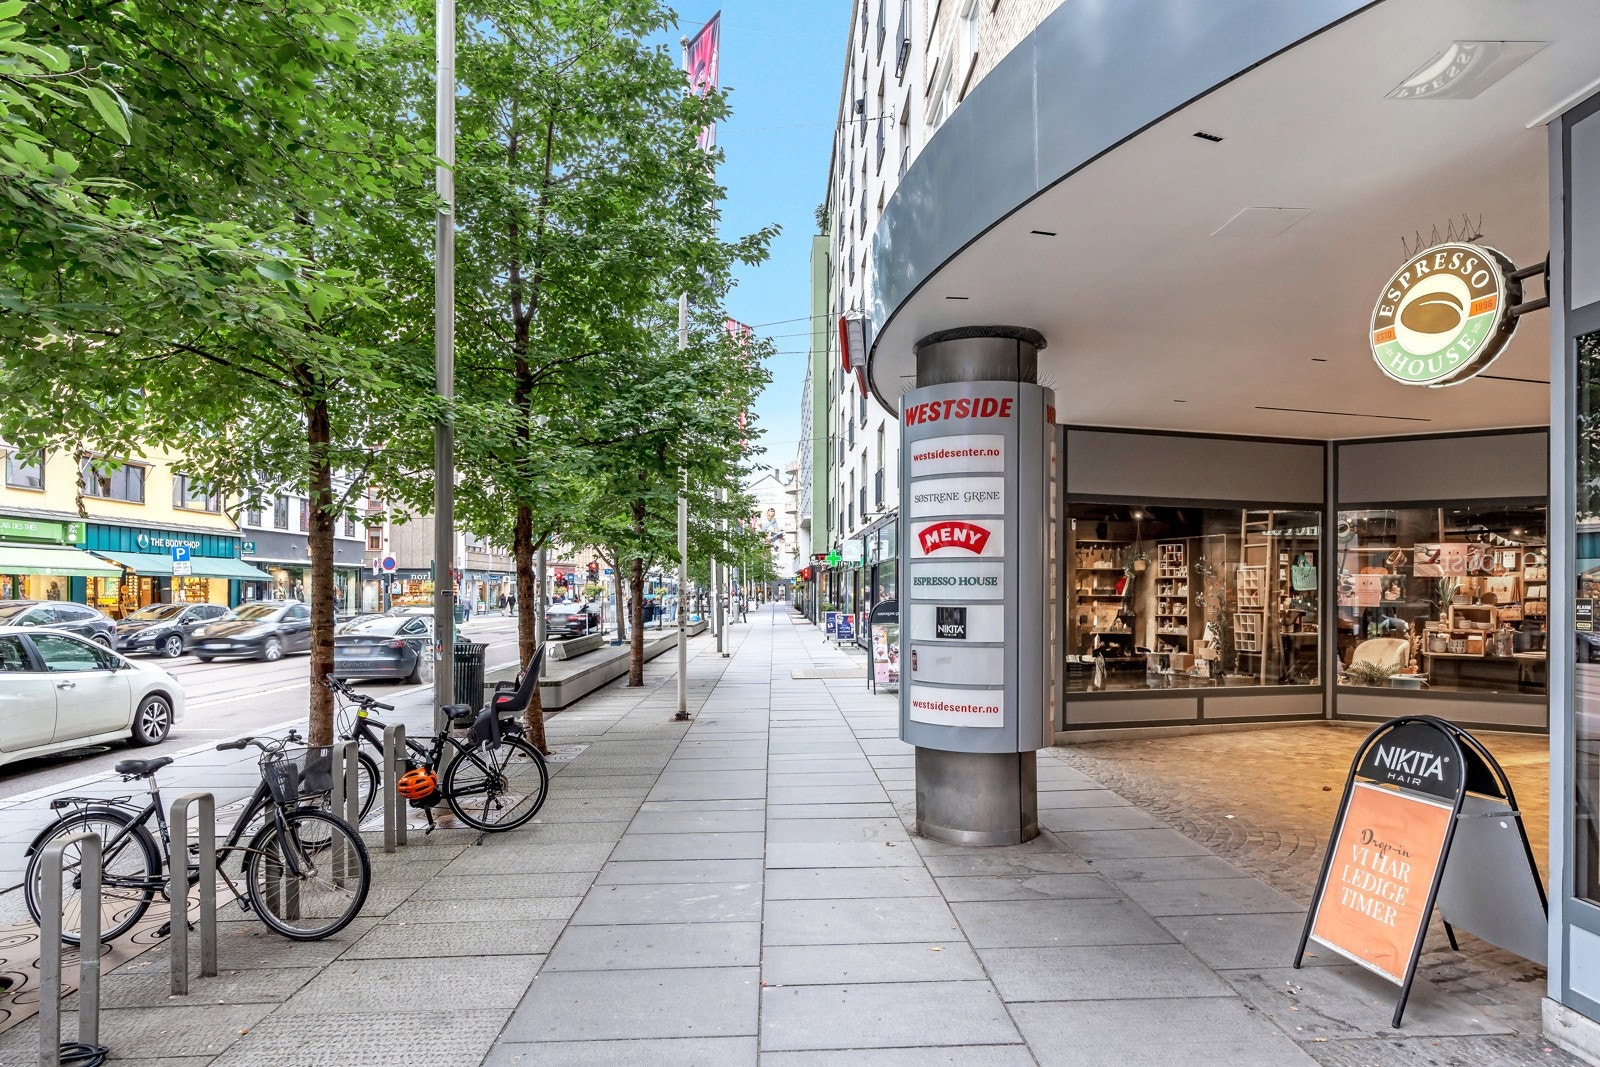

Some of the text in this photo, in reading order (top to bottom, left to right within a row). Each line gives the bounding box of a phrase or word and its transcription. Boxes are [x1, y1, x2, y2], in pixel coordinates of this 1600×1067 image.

[1379, 252, 1489, 318] ESPRESSO
[1376, 331, 1392, 342] ESTD
[1390, 334, 1476, 376] HOUSE
[905, 397, 1014, 428] WESTSIDE
[913, 448, 1000, 462] westsidesenter.no
[914, 490, 1001, 504] SØSTRENE GRENE
[150, 538, 200, 549] THE BODY SHOP
[924, 528, 982, 547] MENY
[176, 548, 186, 560] P
[913, 577, 998, 586] ESPRESSO HOUSE
[937, 624, 964, 634] NIKITA
[912, 700, 999, 714] westsidesenter.no
[1374, 744, 1444, 781] NIKITA
[1387, 772, 1421, 786] HAIR
[1361, 828, 1414, 859] Drop-in
[1352, 844, 1412, 883] VI HAR
[1341, 864, 1409, 906] LEDIGE
[1340, 886, 1397, 926] TIMER
